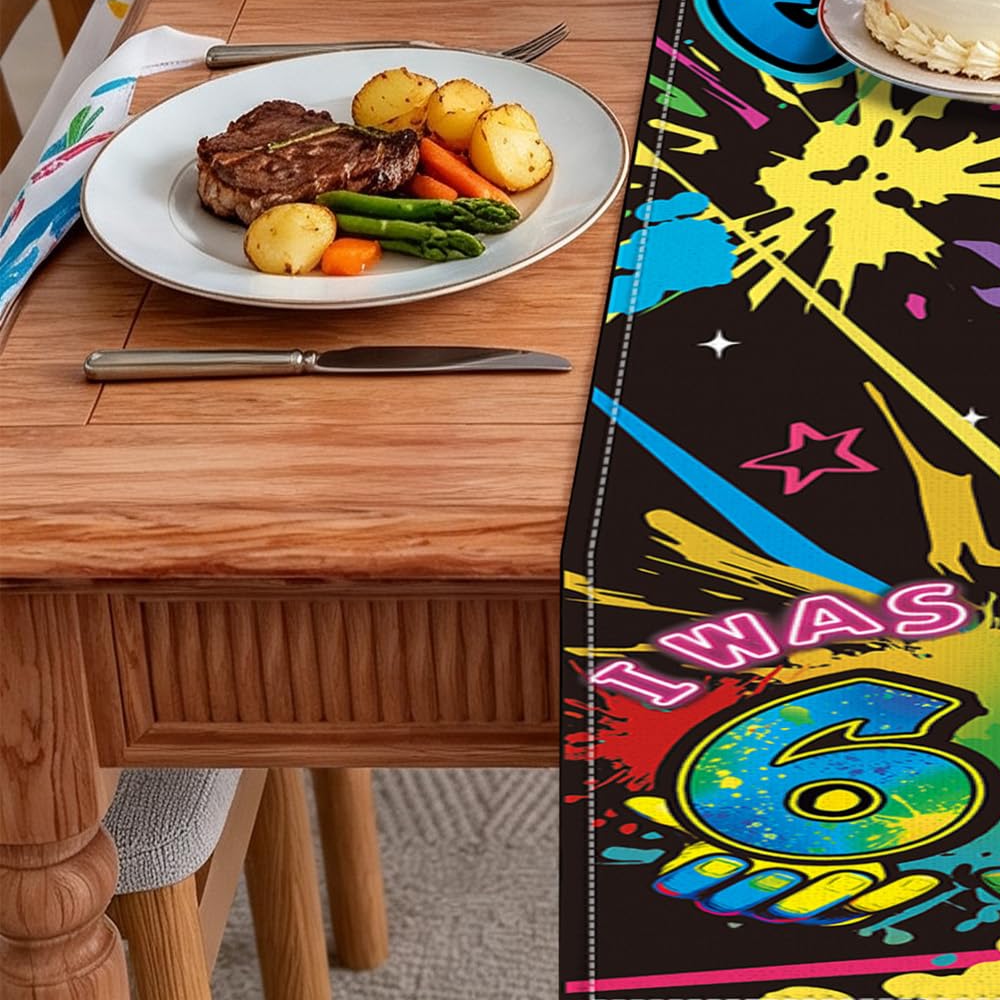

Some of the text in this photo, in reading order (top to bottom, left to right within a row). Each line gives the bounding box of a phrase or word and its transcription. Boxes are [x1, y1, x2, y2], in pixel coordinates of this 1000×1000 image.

[591, 582, 969, 707] I WAS
[676, 676, 988, 867] 6
